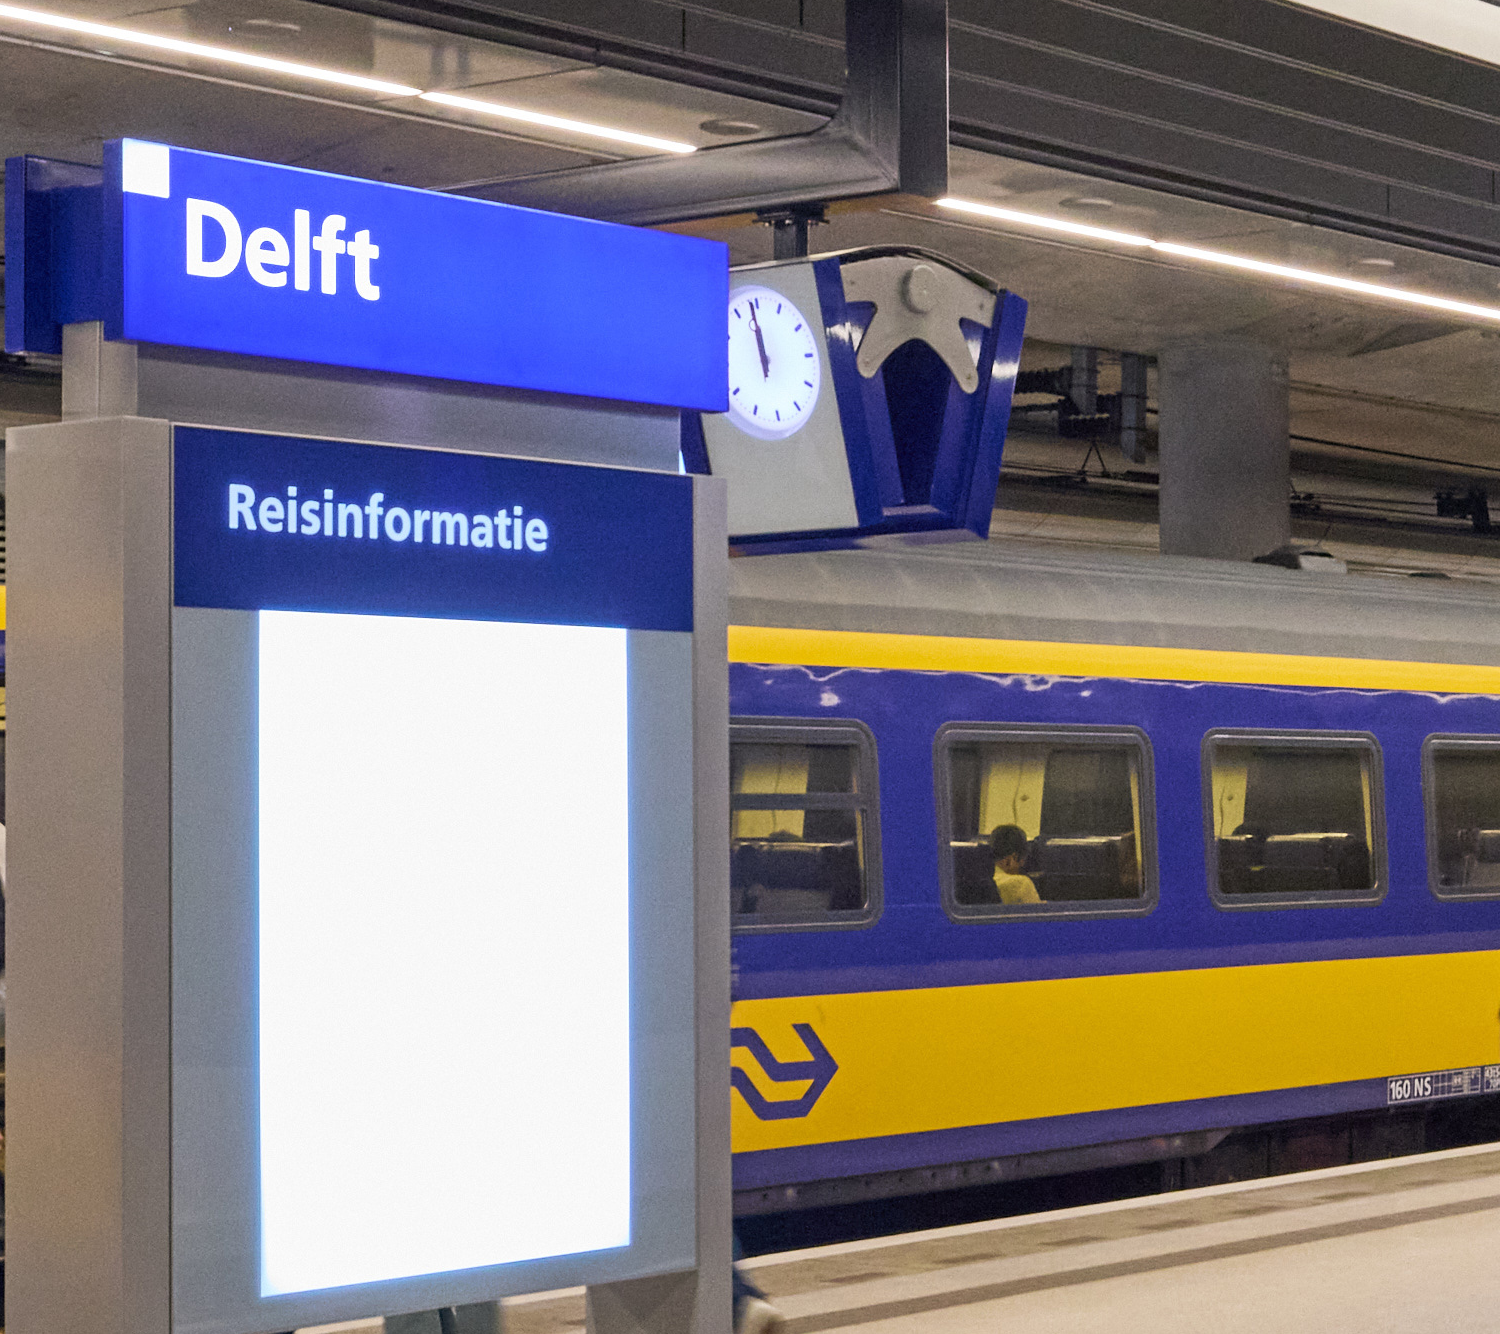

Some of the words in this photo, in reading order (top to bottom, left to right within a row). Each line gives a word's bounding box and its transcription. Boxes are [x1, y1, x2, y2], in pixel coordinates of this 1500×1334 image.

[184, 197, 381, 303] Delft
[227, 482, 550, 555] Reisinformatie
[1389, 1080, 1412, 1100] 160
[1414, 1076, 1432, 1097] NS
